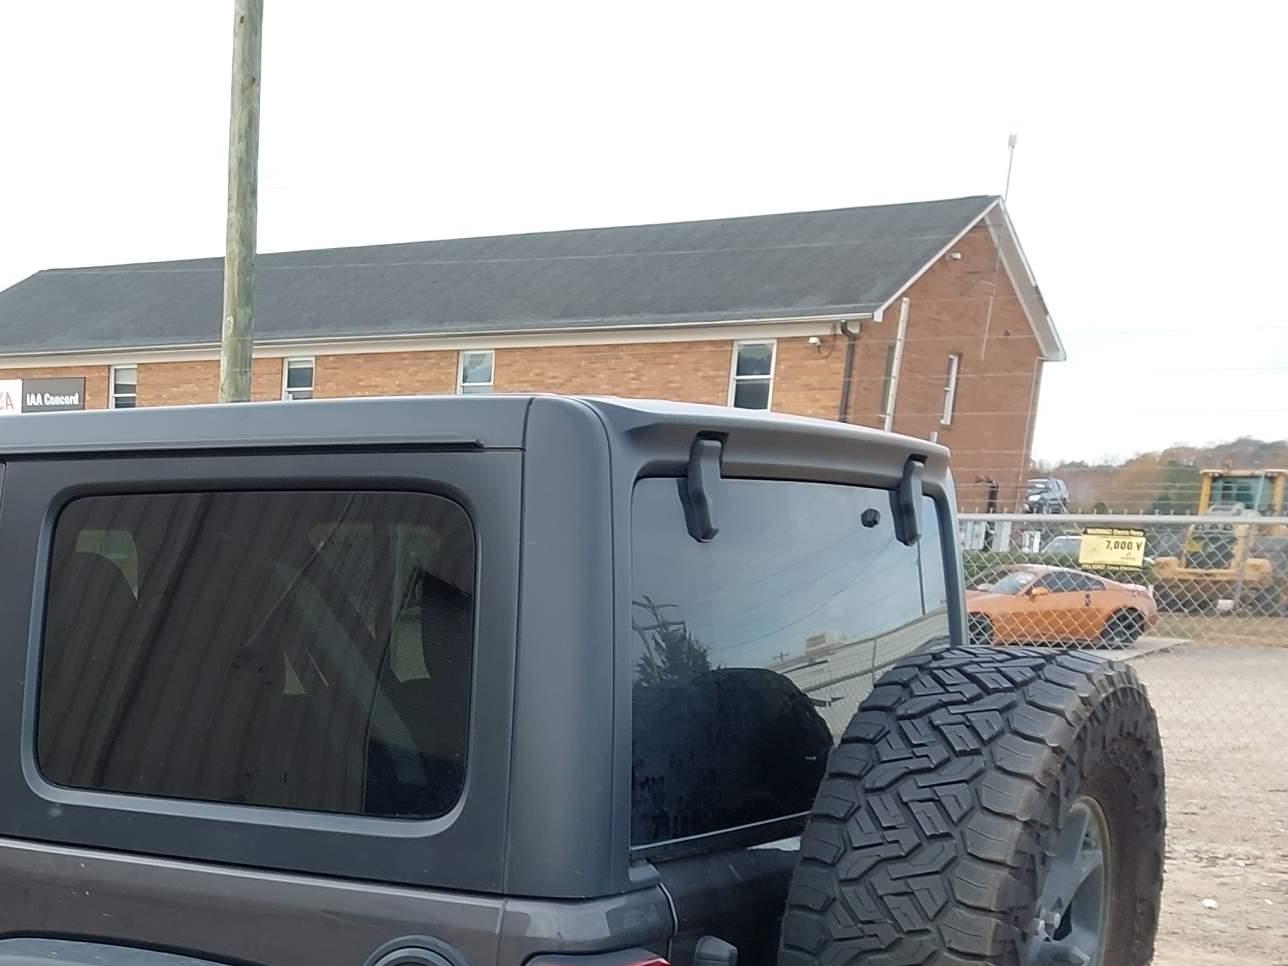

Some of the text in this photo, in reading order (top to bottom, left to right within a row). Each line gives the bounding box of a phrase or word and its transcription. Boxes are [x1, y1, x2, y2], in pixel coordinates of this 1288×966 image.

[26, 392, 79, 406] IAA Concord
[1105, 540, 1143, 551] 7,000 V
